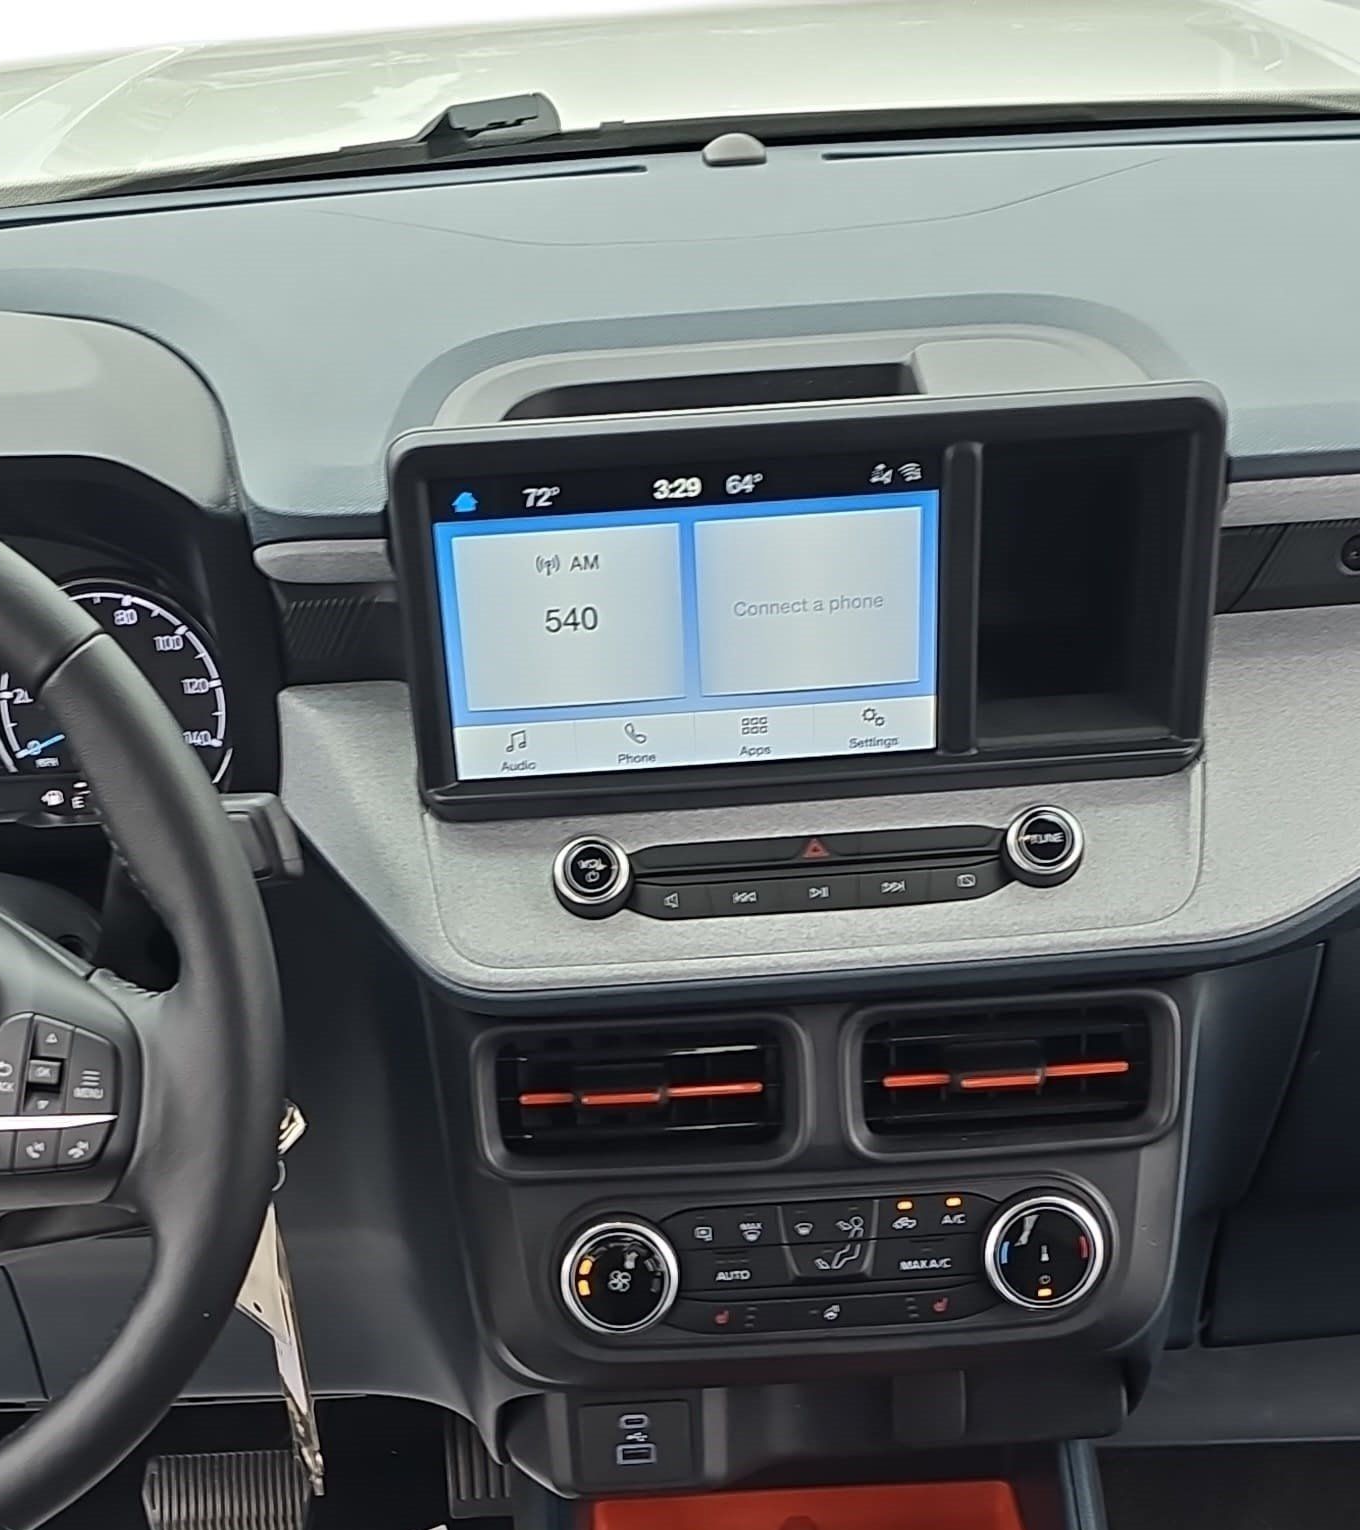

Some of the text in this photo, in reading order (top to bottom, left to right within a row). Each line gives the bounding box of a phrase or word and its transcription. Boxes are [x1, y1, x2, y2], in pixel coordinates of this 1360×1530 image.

[653, 477, 702, 500] 3:29
[569, 554, 600, 572] AM
[733, 593, 884, 618] Connect a phone
[114, 609, 138, 625] 80
[544, 606, 599, 633] 540
[153, 635, 184, 651] 100
[181, 678, 209, 694] 120
[849, 735, 900, 750] Settings
[617, 751, 656, 765] Phone
[739, 745, 771, 758] Apps
[501, 759, 537, 772] Audio
[73, 1087, 103, 1099] MENU
[941, 1213, 967, 1225] A/C
[740, 1222, 762, 1231] MAX
[900, 1257, 952, 1270] MAX A/C
[715, 1270, 751, 1281] AUTO
